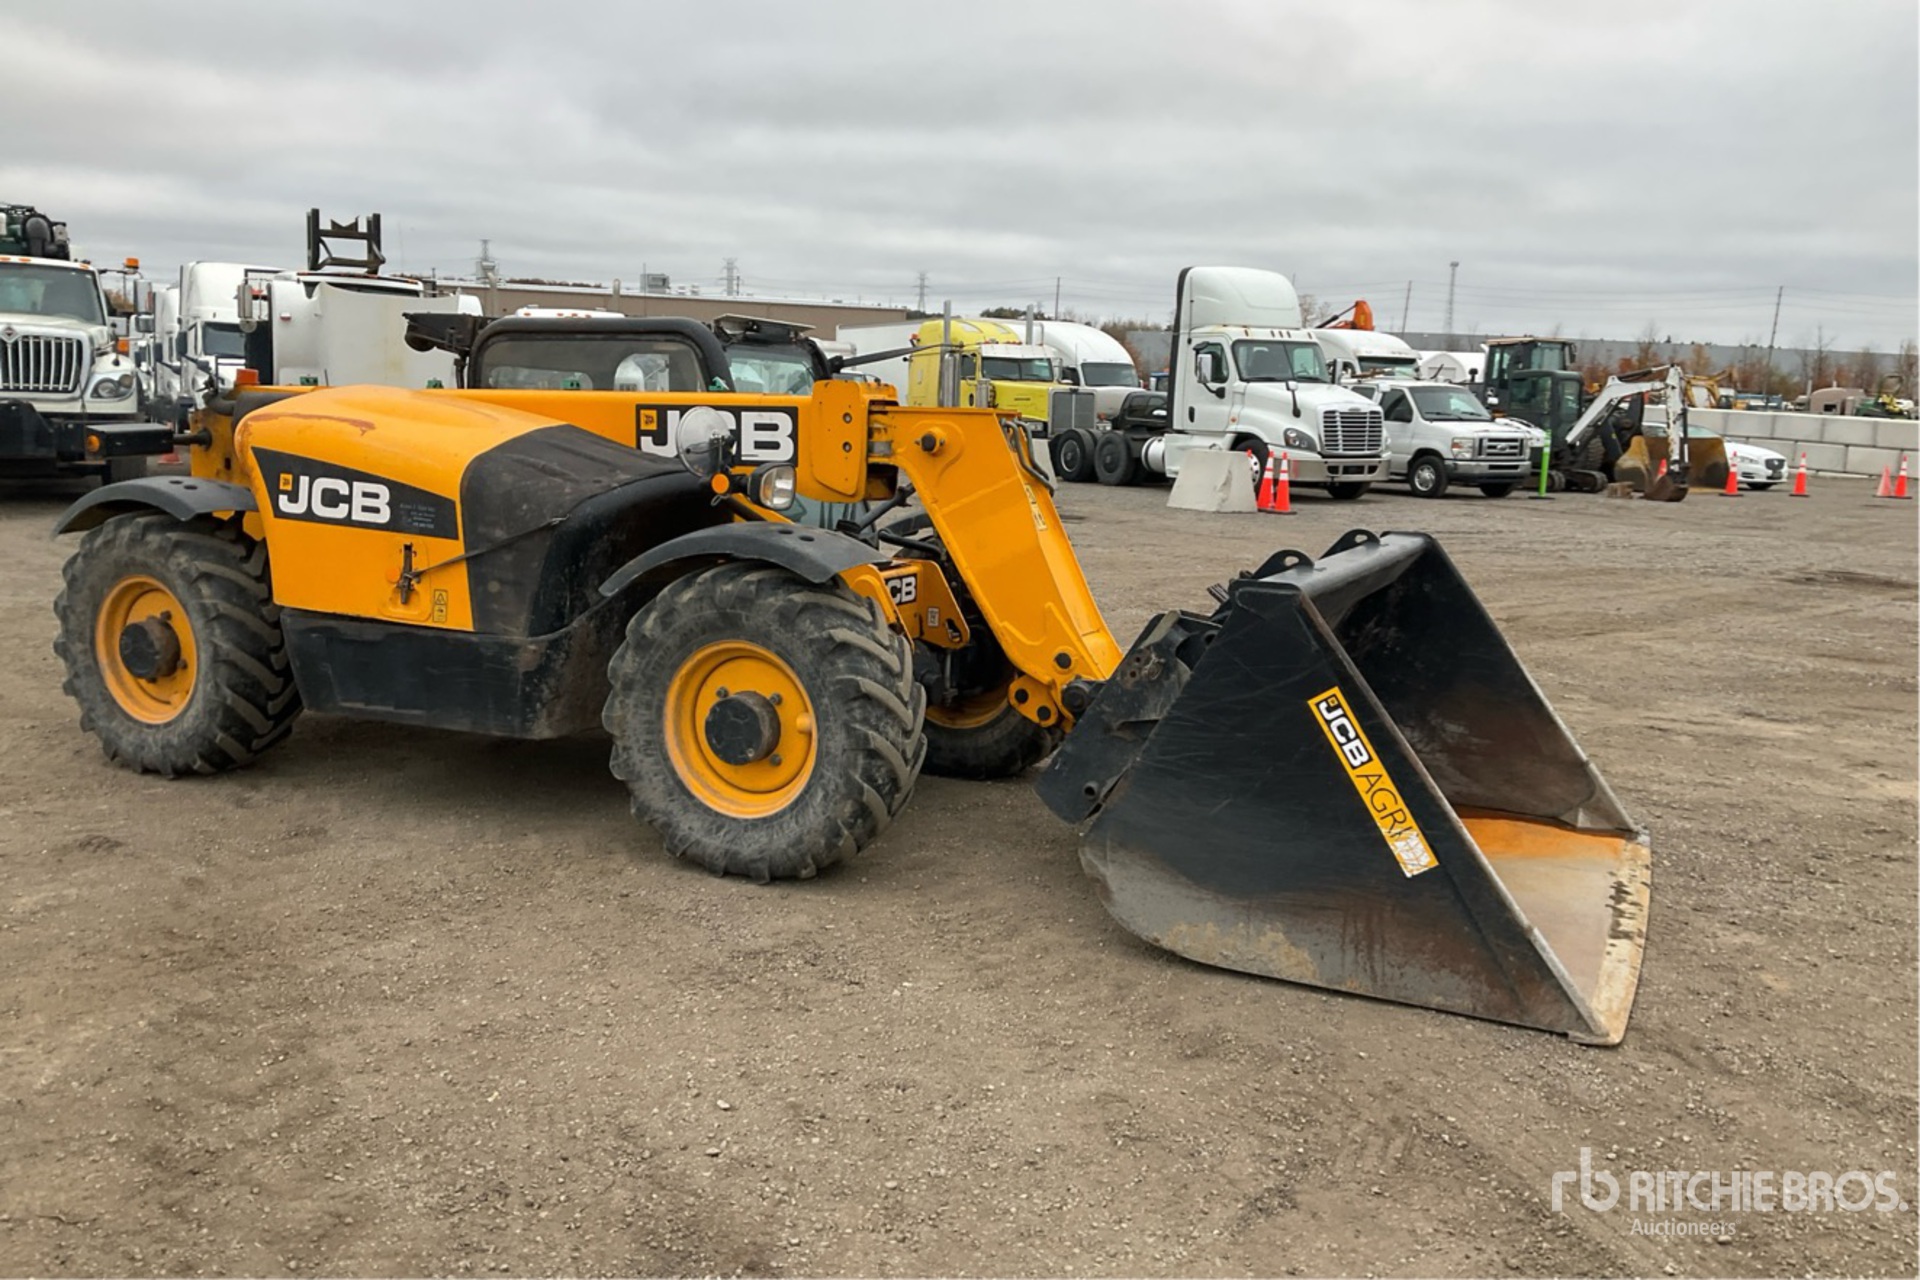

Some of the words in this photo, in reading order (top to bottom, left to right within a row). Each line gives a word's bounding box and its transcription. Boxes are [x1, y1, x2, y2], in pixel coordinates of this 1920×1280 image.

[278, 475, 391, 524] JCB
[886, 576, 917, 604] CB
[1318, 699, 1370, 768] JCB
